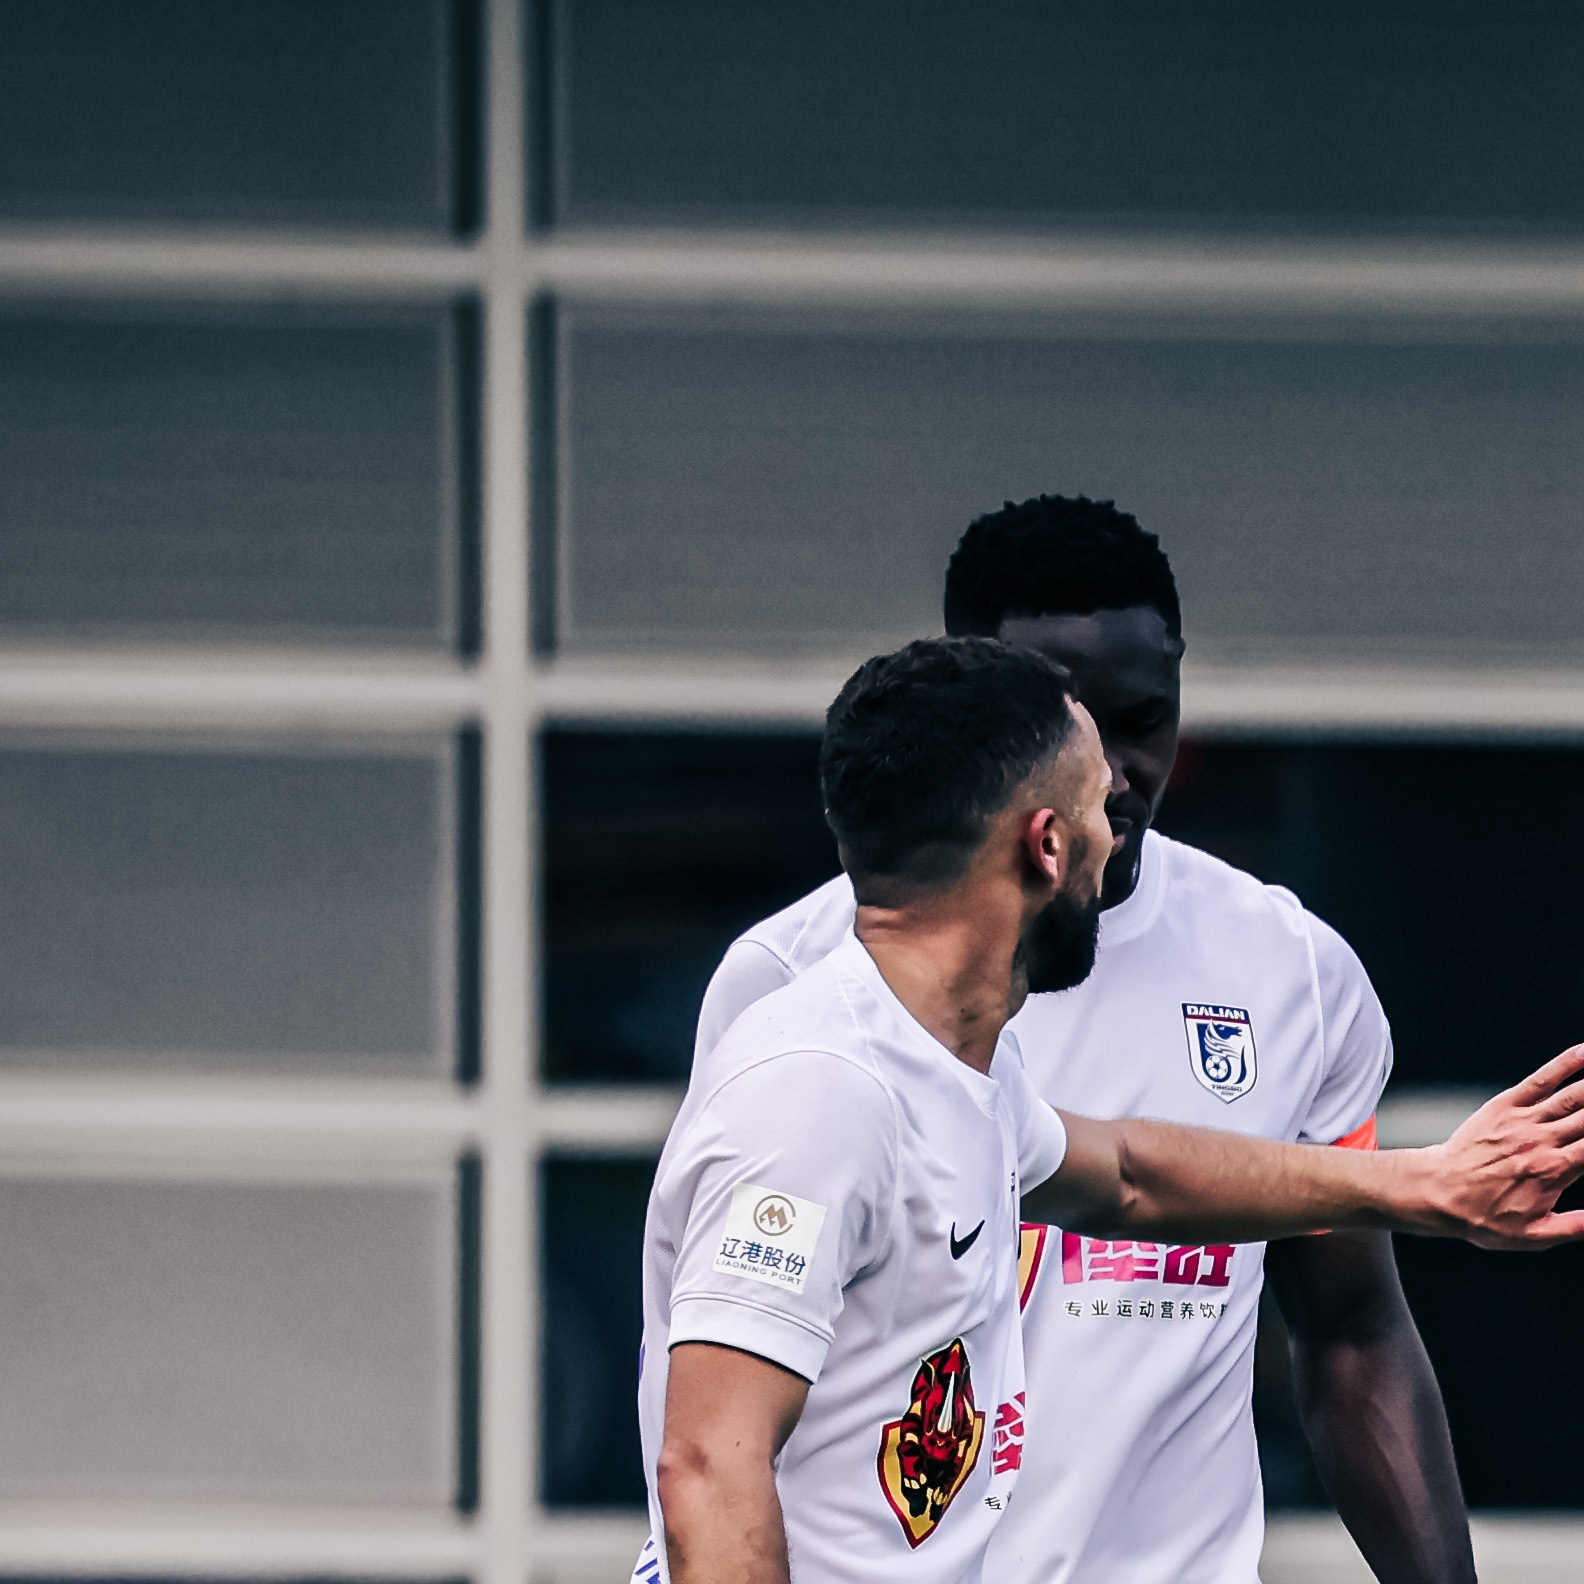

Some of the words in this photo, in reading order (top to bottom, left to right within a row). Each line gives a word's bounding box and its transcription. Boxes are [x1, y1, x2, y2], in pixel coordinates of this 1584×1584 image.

[1186, 1004, 1246, 1021] DALIAN
[720, 1236, 806, 1276] 辽港股份
[715, 1258, 768, 1276] LIAONING
[771, 1270, 804, 1287] PORT
